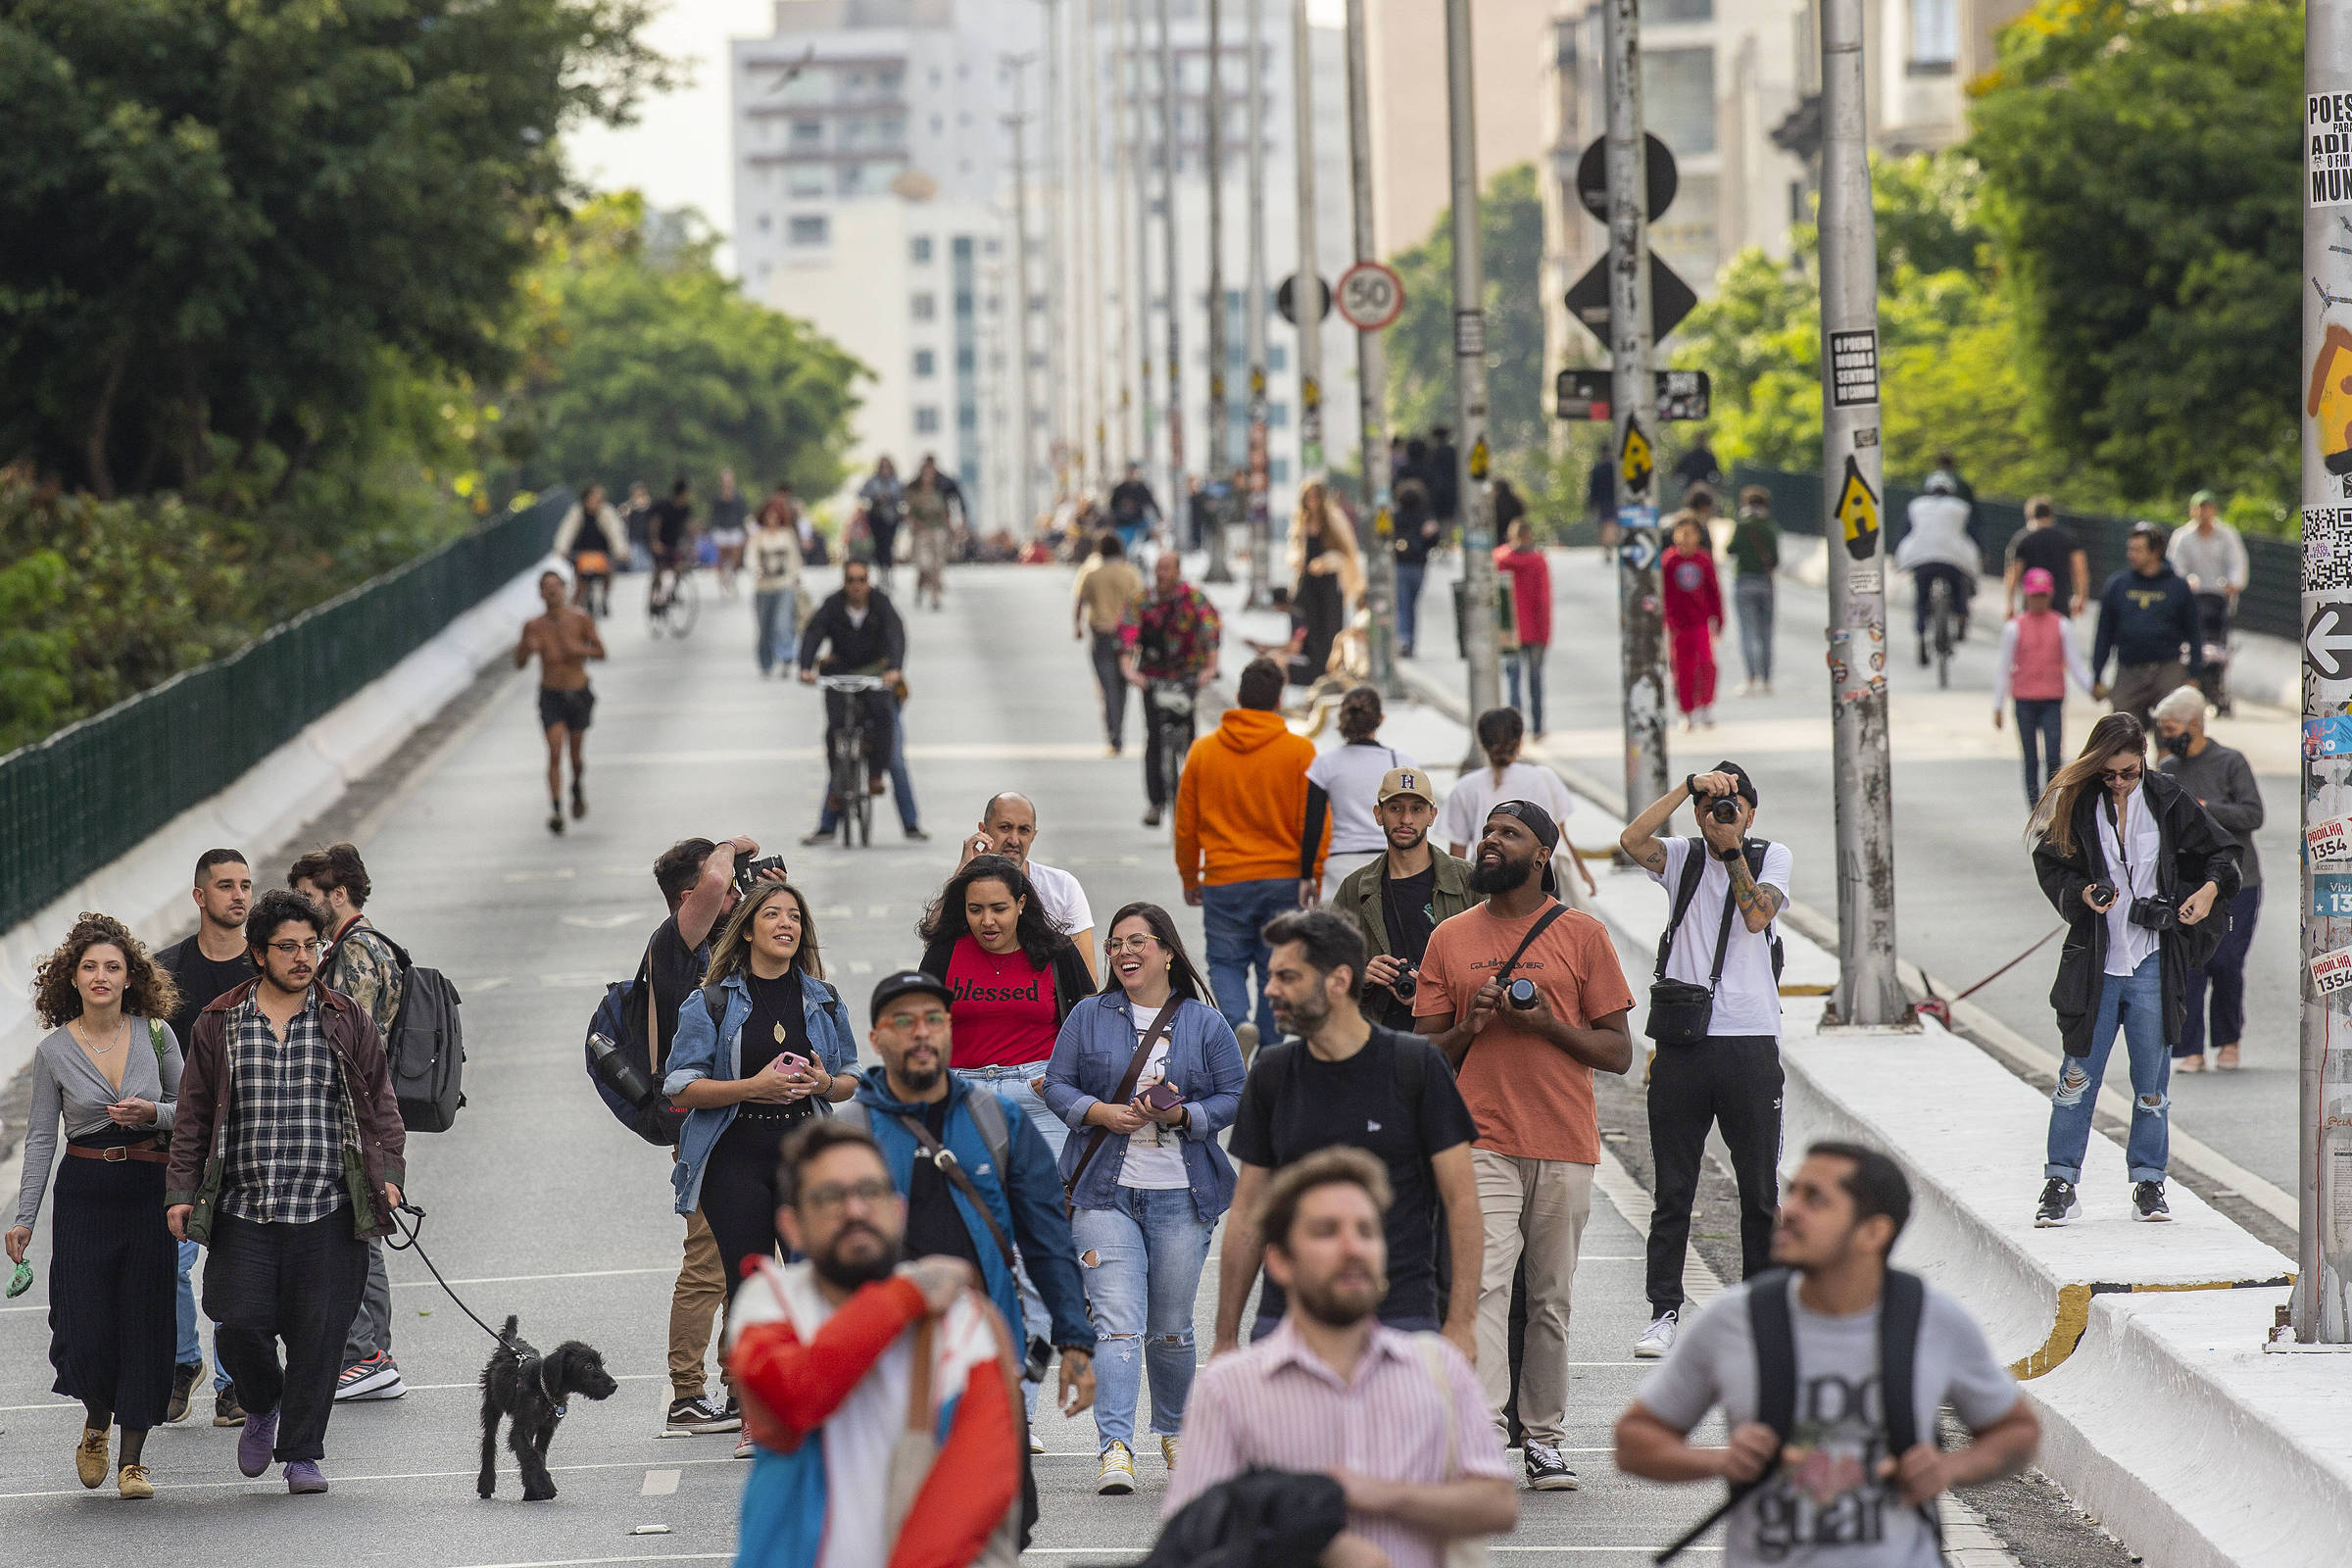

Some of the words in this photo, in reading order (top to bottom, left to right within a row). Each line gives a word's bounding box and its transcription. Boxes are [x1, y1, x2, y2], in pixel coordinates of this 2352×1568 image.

[2309, 93, 2352, 124] POES
[2312, 133, 2352, 155] ADI
[2328, 155, 2332, 168] O
[2336, 154, 2350, 167] FIM
[2313, 169, 2352, 202] MUN
[1350, 276, 1392, 309] 50
[1400, 774, 1415, 789] H
[2307, 822, 2344, 847] PADILHA
[2311, 837, 2347, 860] 1354
[2330, 893, 2352, 912] 13
[2313, 955, 2351, 979] PADILHA
[955, 977, 1039, 1003] blessed
[2317, 970, 2352, 993] 1354
